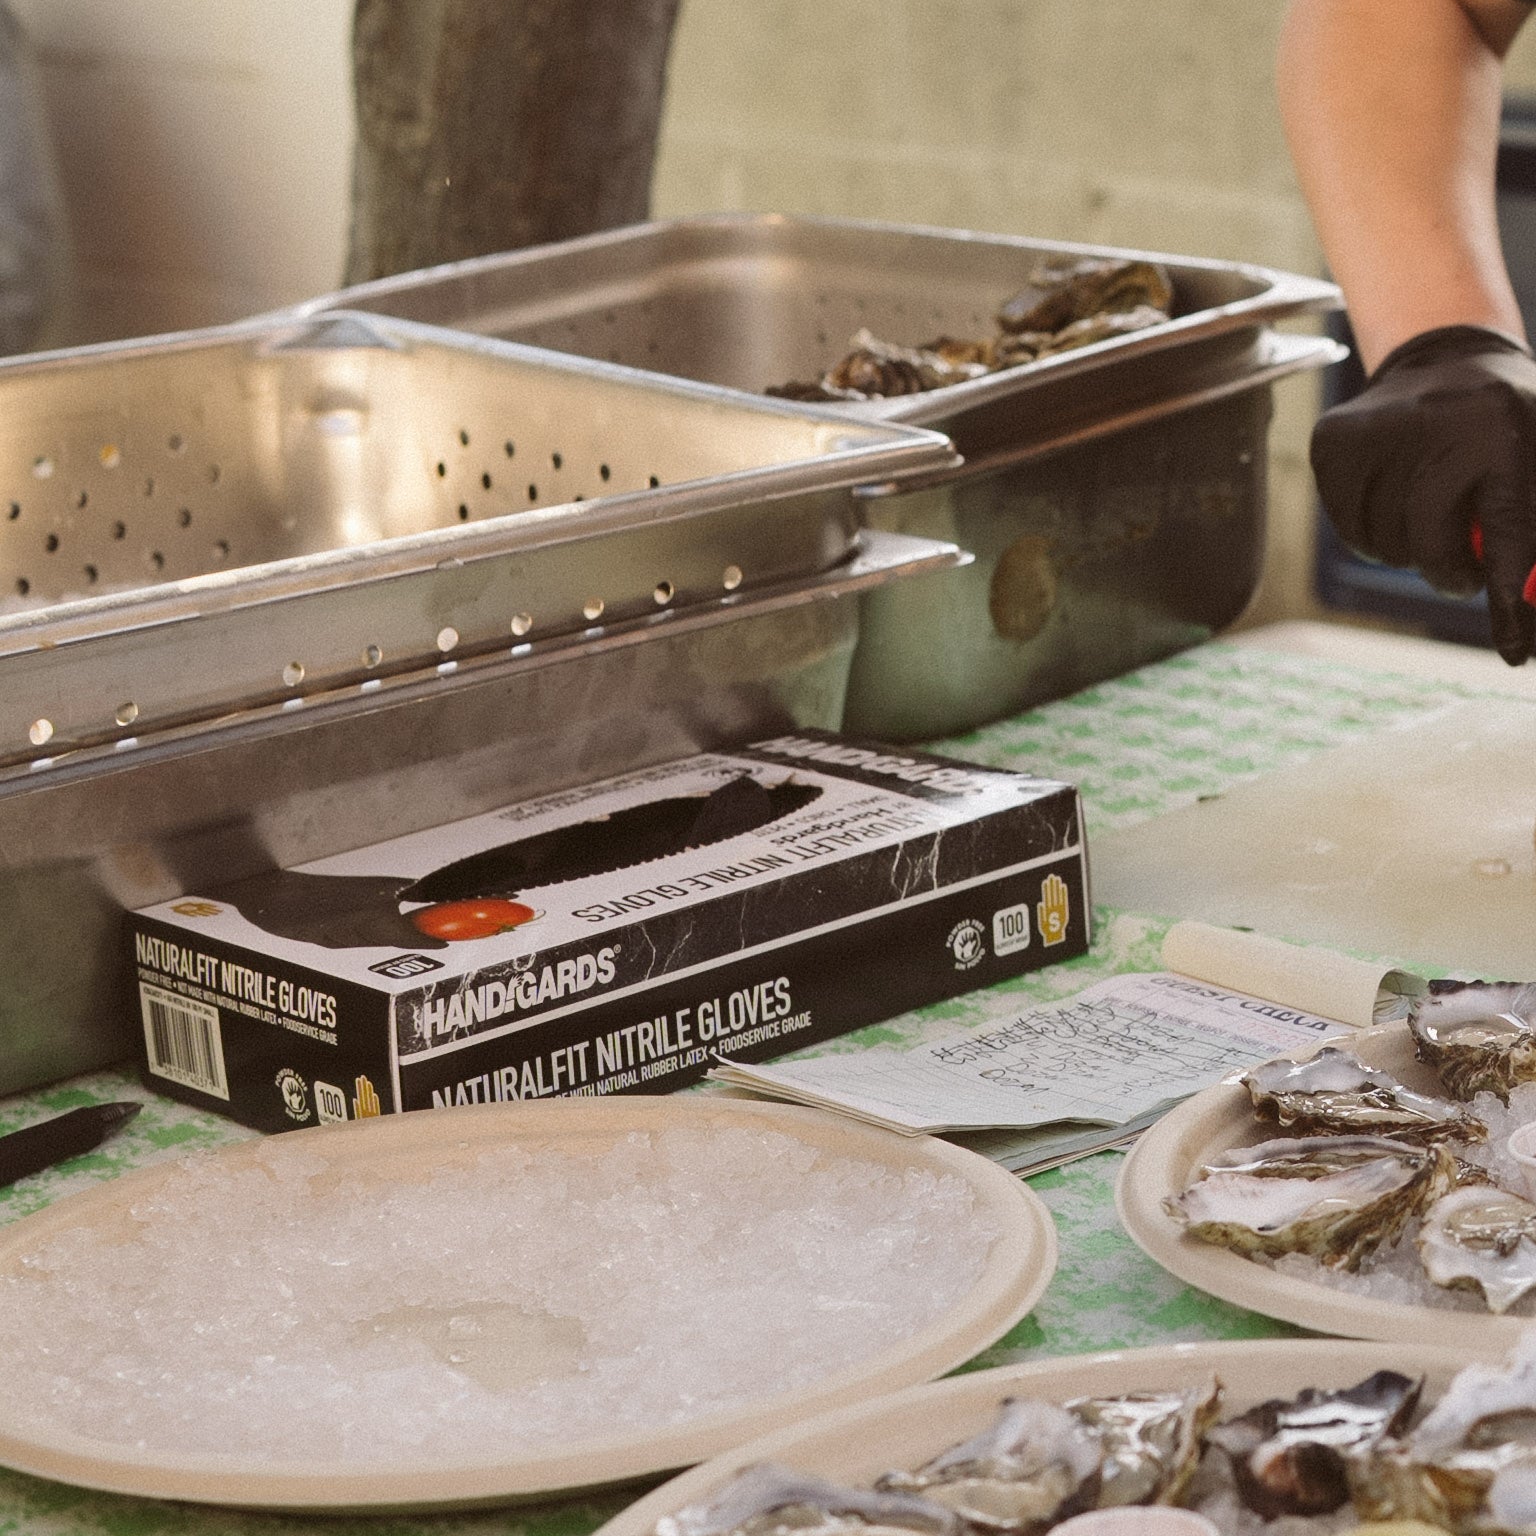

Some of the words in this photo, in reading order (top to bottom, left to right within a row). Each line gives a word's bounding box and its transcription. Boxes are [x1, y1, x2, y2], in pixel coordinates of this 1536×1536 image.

[787, 807, 943, 864] ATURALFIT
[687, 842, 790, 891] NITRILE
[573, 870, 690, 924] GLOVES
[999, 911, 1024, 939] 100
[1048, 911, 1061, 933] S
[136, 931, 219, 989] NATURALFIT
[221, 960, 276, 1009] NITRILE
[278, 980, 337, 1029] GLOVES
[386, 960, 434, 977] 100
[1239, 991, 1330, 1033] CHECK
[431, 1041, 589, 1111] NATURALFIT
[596, 1006, 692, 1078] NITRILE
[697, 975, 792, 1043] GLOVES
[596, 1069, 640, 1097] NATURAL
[641, 1055, 679, 1081] RUBBER
[679, 1044, 709, 1070] LATEX
[718, 1023, 781, 1056] FOODSERVICE
[781, 1009, 812, 1038] GRADE
[319, 1088, 342, 1119] 100
